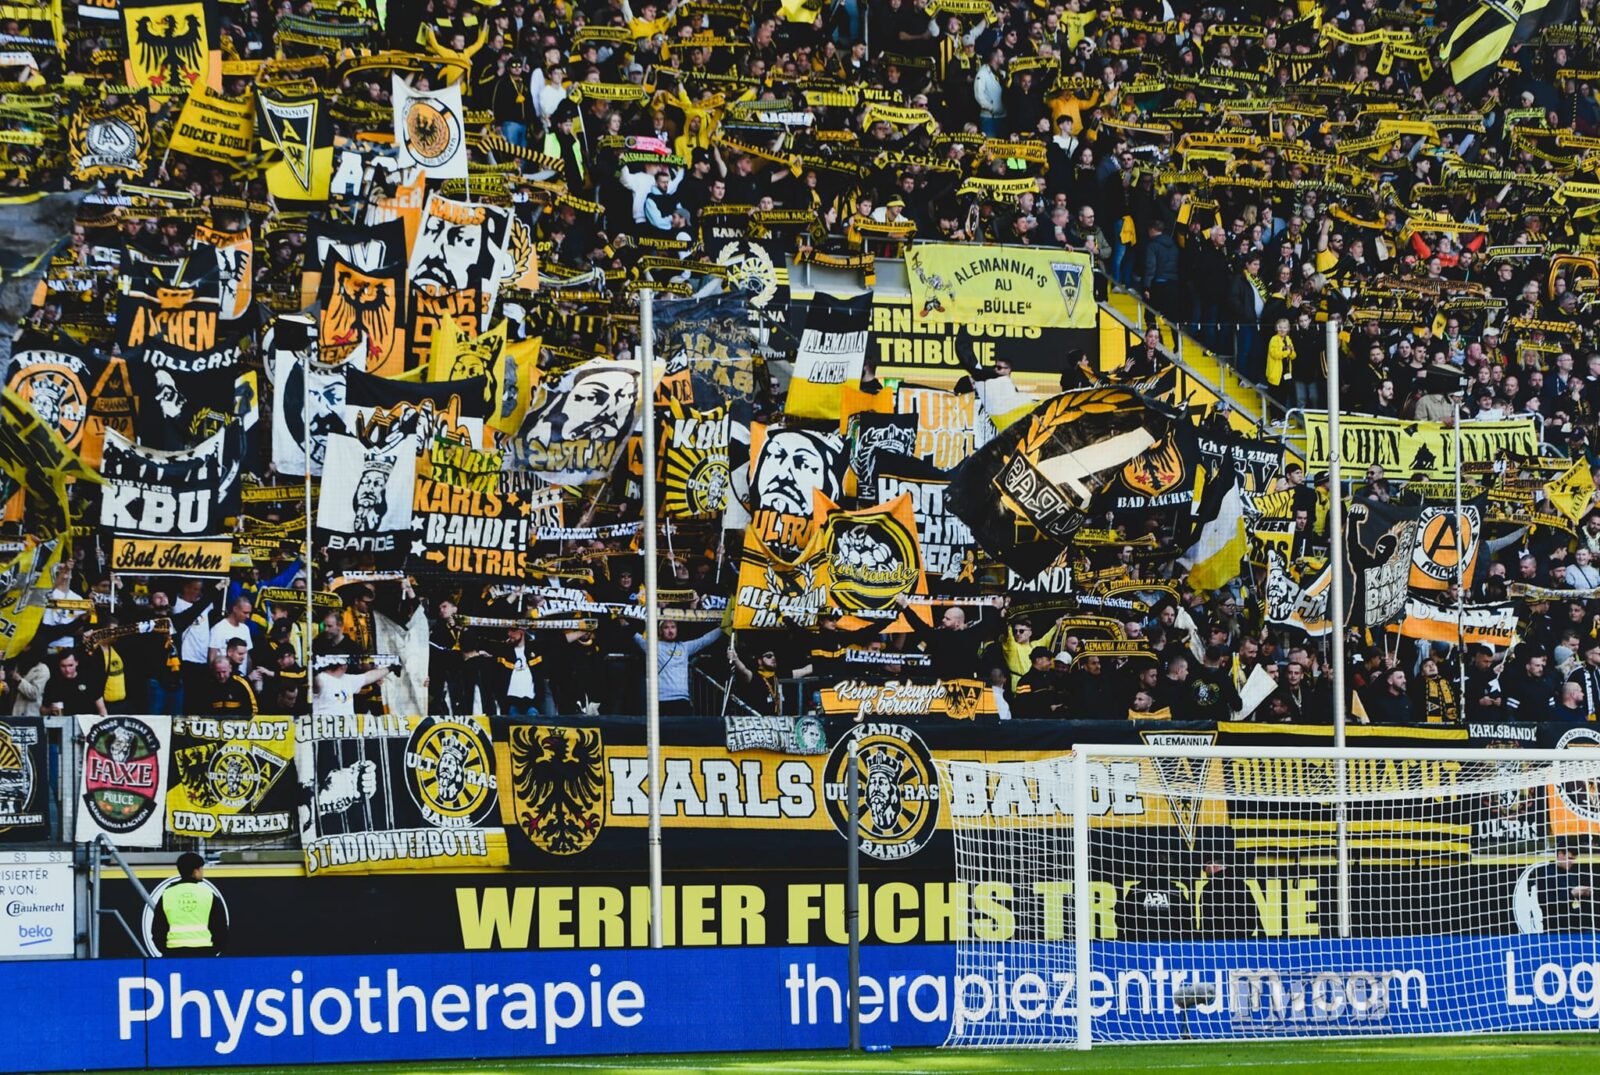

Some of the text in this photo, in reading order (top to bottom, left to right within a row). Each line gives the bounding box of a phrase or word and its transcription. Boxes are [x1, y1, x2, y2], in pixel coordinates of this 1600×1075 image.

[1210, 66, 1260, 82] ALEMANNIA
[864, 88, 892, 102] WILL
[179, 122, 217, 144] DICKE
[1337, 129, 1400, 148] ALEMANNIA AACHEN
[1457, 169, 1467, 179] DIE
[1468, 169, 1488, 180] MACHT
[1001, 182, 1027, 192] AACHEN
[1565, 184, 1600, 195] ALEMANNI
[429, 197, 487, 226] KARLS
[638, 237, 688, 250] AUFSTEIGER
[712, 226, 773, 240] RABAN
[953, 257, 1048, 289] ALEMANNIA'S
[995, 278, 1013, 292] AU
[977, 297, 1032, 317] „BÜLLE“
[18, 351, 85, 374] KARLS
[93, 415, 128, 437] 1900
[673, 413, 729, 449] KBU
[431, 440, 504, 474] KARLS
[1198, 437, 1219, 453] Ich
[1247, 450, 1279, 463] zum
[415, 478, 503, 518] KARLS
[1117, 489, 1195, 509] BAD AACHEN
[1253, 489, 1296, 518] BANDE
[100, 485, 212, 534] KBU
[426, 512, 529, 551] BANDE!
[328, 534, 396, 552] BANDE
[116, 541, 223, 571] Bad Aachen
[447, 546, 528, 579] ULTRAS
[1420, 560, 1468, 579] AACHN
[299, 591, 332, 603] ACHEN
[752, 608, 818, 629] AAEN
[833, 678, 948, 702] Keine Sekunde
[853, 698, 873, 722] je
[174, 716, 289, 741] FÜR STADT
[295, 713, 411, 743] GEGEN ALLE
[727, 730, 781, 747] STERBEN
[852, 722, 914, 744] KARLS
[1152, 735, 1210, 747] ALEMANNIA
[89, 755, 154, 787] FAXE
[406, 751, 498, 789] ULT RAS
[103, 791, 134, 805] POLICE
[607, 757, 818, 819] KARLS
[903, 784, 940, 801] RAS
[949, 760, 1145, 817] BANDE
[121, 808, 149, 829] AACHEN
[173, 811, 290, 834] UND VEREIN
[422, 806, 474, 828] BANDE
[14, 853, 62, 863] S3 S3
[307, 828, 488, 874] STADIONVERBOTE!
[859, 838, 921, 858] BANDE
[9, 885, 38, 896] VON:
[9, 902, 65, 917] Bauknecht
[455, 877, 1320, 950] WERNER FUCHS TRNE
[18, 924, 54, 940] beko
[1506, 950, 1600, 1019] Log
[784, 957, 1429, 1037] therapiezentrum.com
[117, 963, 646, 1055] Physiotherapie
